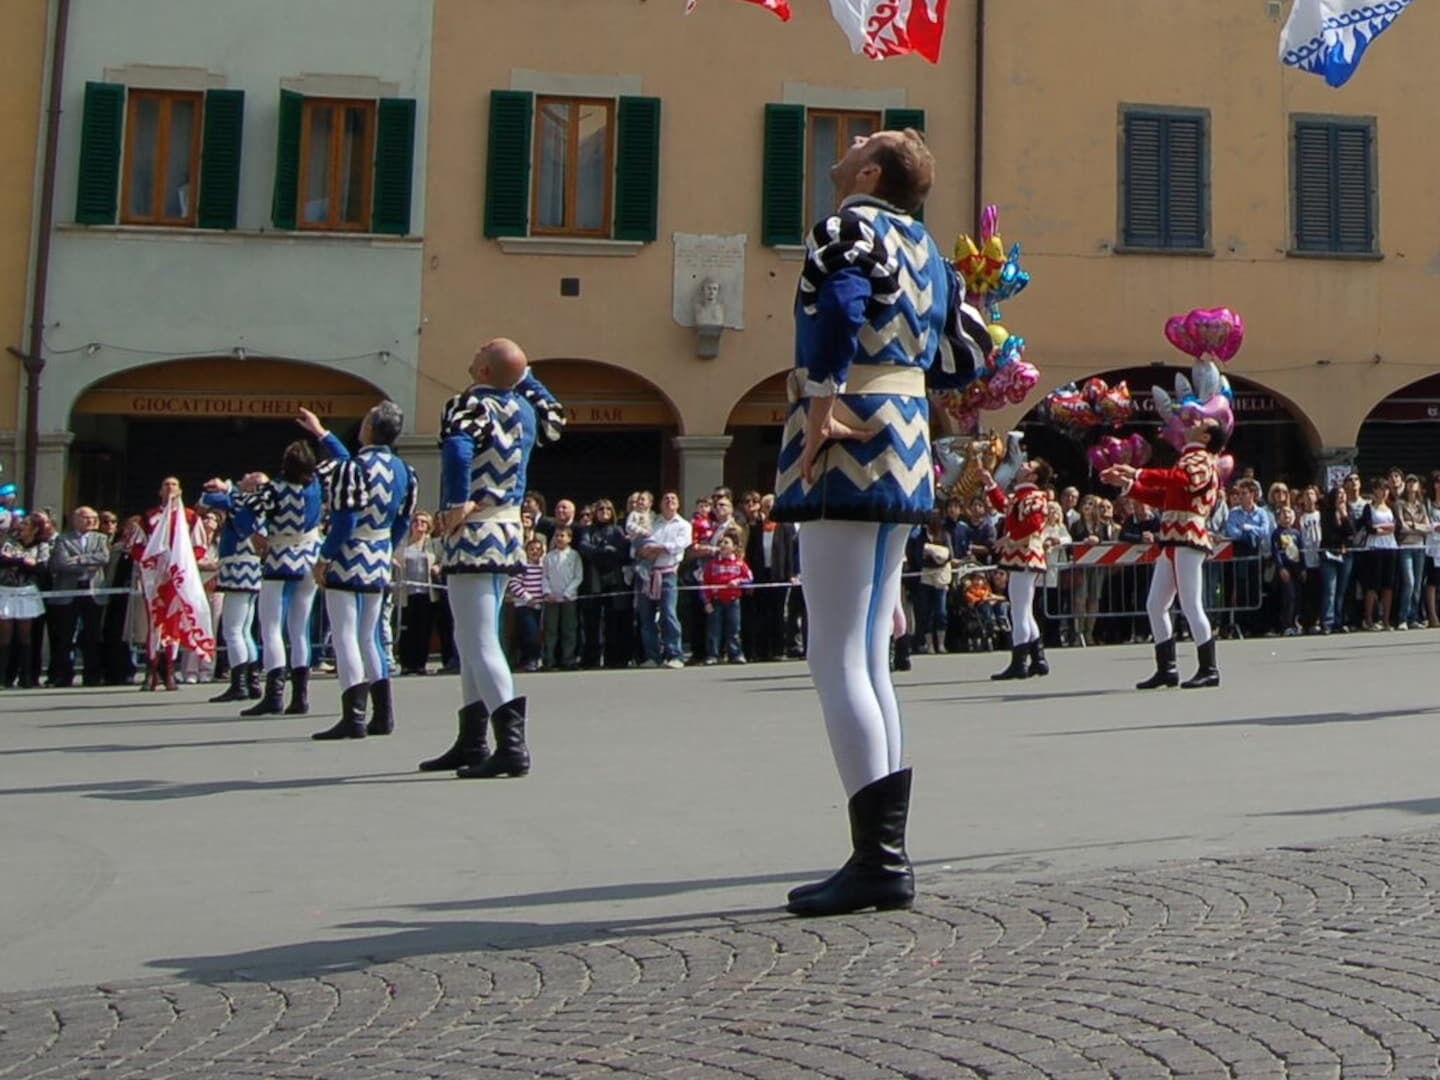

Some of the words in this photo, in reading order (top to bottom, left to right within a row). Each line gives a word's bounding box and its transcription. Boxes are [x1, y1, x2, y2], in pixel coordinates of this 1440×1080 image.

[132, 396, 244, 413] GIOCATTOLI
[248, 398, 334, 415] CHELLINI
[590, 406, 624, 422] BAR
